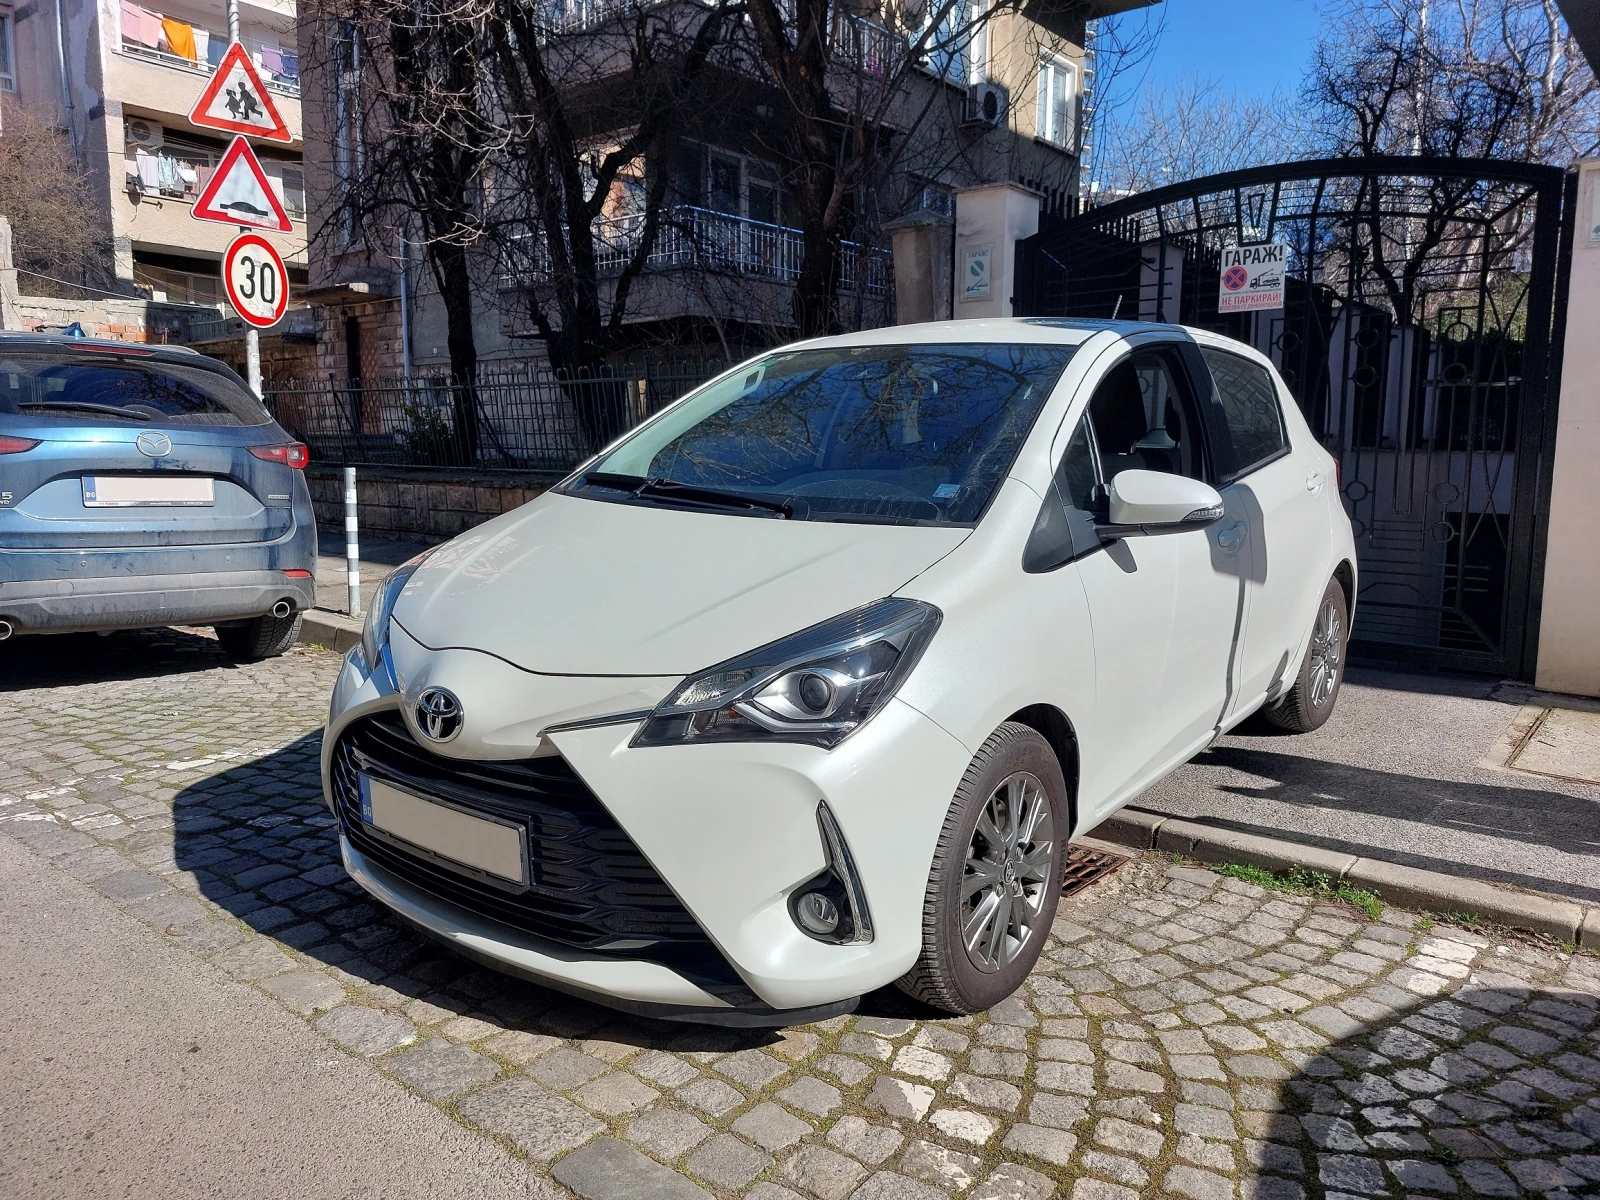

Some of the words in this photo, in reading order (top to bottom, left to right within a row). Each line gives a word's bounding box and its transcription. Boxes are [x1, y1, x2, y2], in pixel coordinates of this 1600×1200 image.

[968, 250, 988, 258] ГАРАЖ!
[1225, 245, 1284, 267] ГАРАЖ!
[240, 256, 275, 304] 30
[1222, 296, 1232, 305] НЕ
[1234, 292, 1282, 304] ПАРКИРАЙ!
[363, 804, 372, 817] BG
